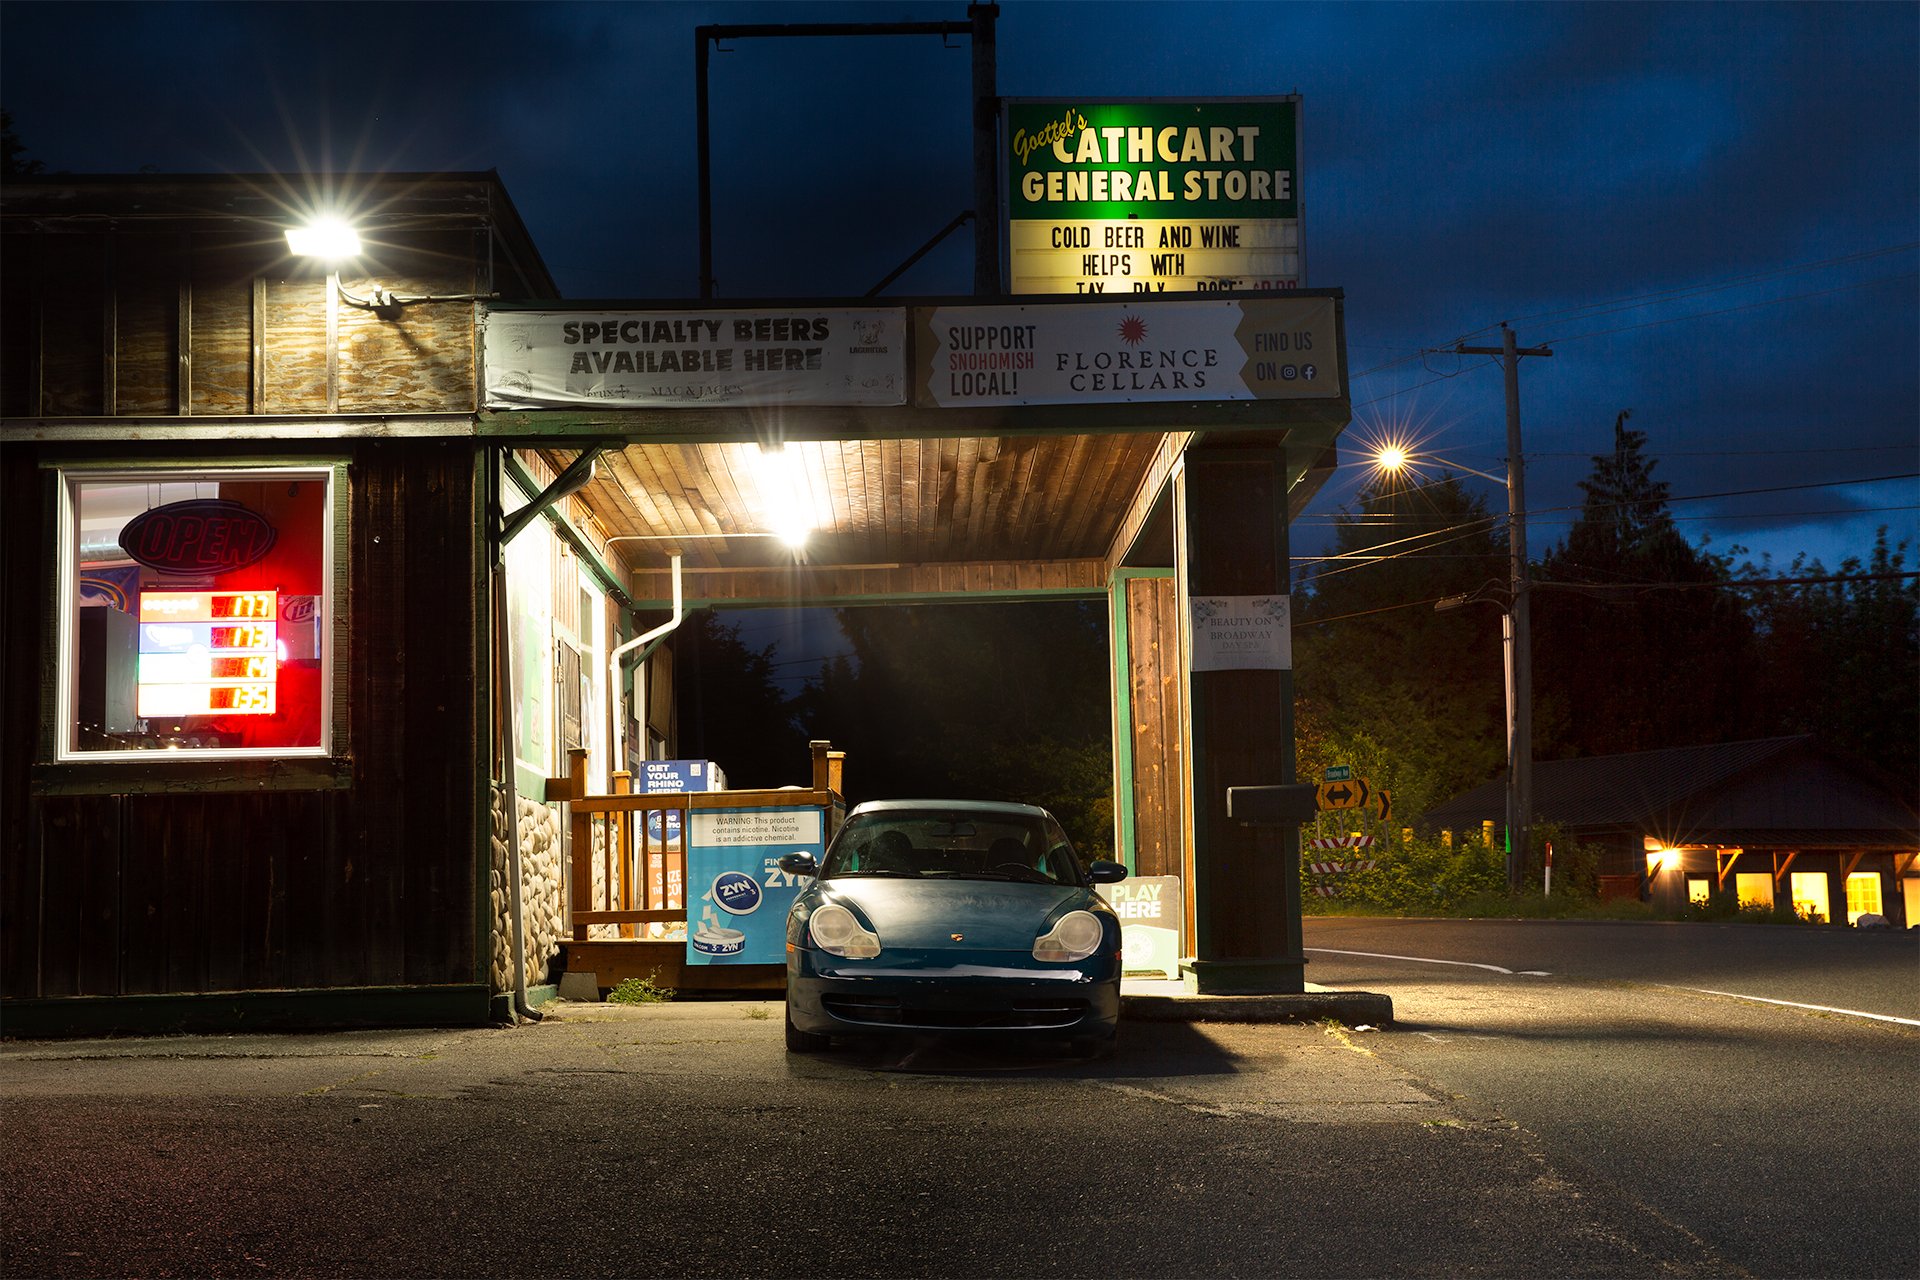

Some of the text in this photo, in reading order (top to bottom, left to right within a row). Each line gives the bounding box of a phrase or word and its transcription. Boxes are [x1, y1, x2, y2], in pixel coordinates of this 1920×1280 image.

[1013, 107, 1088, 166] Goettel's
[1052, 126, 1260, 164] CATHCART
[1021, 170, 1291, 202] GENERAL STORE
[1052, 225, 1240, 249] COLD BEER AND WINE
[1082, 253, 1184, 276] HELPS WITH
[563, 317, 830, 345] SPECIALTY BEERS
[948, 325, 1036, 351] SUPPORT
[1254, 331, 1313, 352] FIND US
[570, 347, 823, 375] AVAILABLE HERE
[949, 352, 1035, 371] SNOHOMISH
[1056, 349, 1219, 371] FLORENCE
[1070, 370, 1207, 392] CELLARS
[1256, 362, 1277, 381] ON
[950, 372, 1018, 396] LOCAL!
[139, 515, 258, 564] OPEN
[1210, 617, 1272, 626] BEAUTY ON
[1210, 631, 1272, 640] BROADWAY
[647, 764, 670, 772] GET
[647, 772, 679, 780] YOUR
[647, 780, 684, 788] RHINO
[716, 817, 795, 826] WARNING: This product
[764, 858, 780, 866] FIN
[656, 870, 681, 886] SIZE
[719, 880, 751, 896] ZYN
[1111, 884, 1162, 902] PLAY
[1111, 901, 1161, 918] HERE
[722, 944, 738, 952] ZYN
